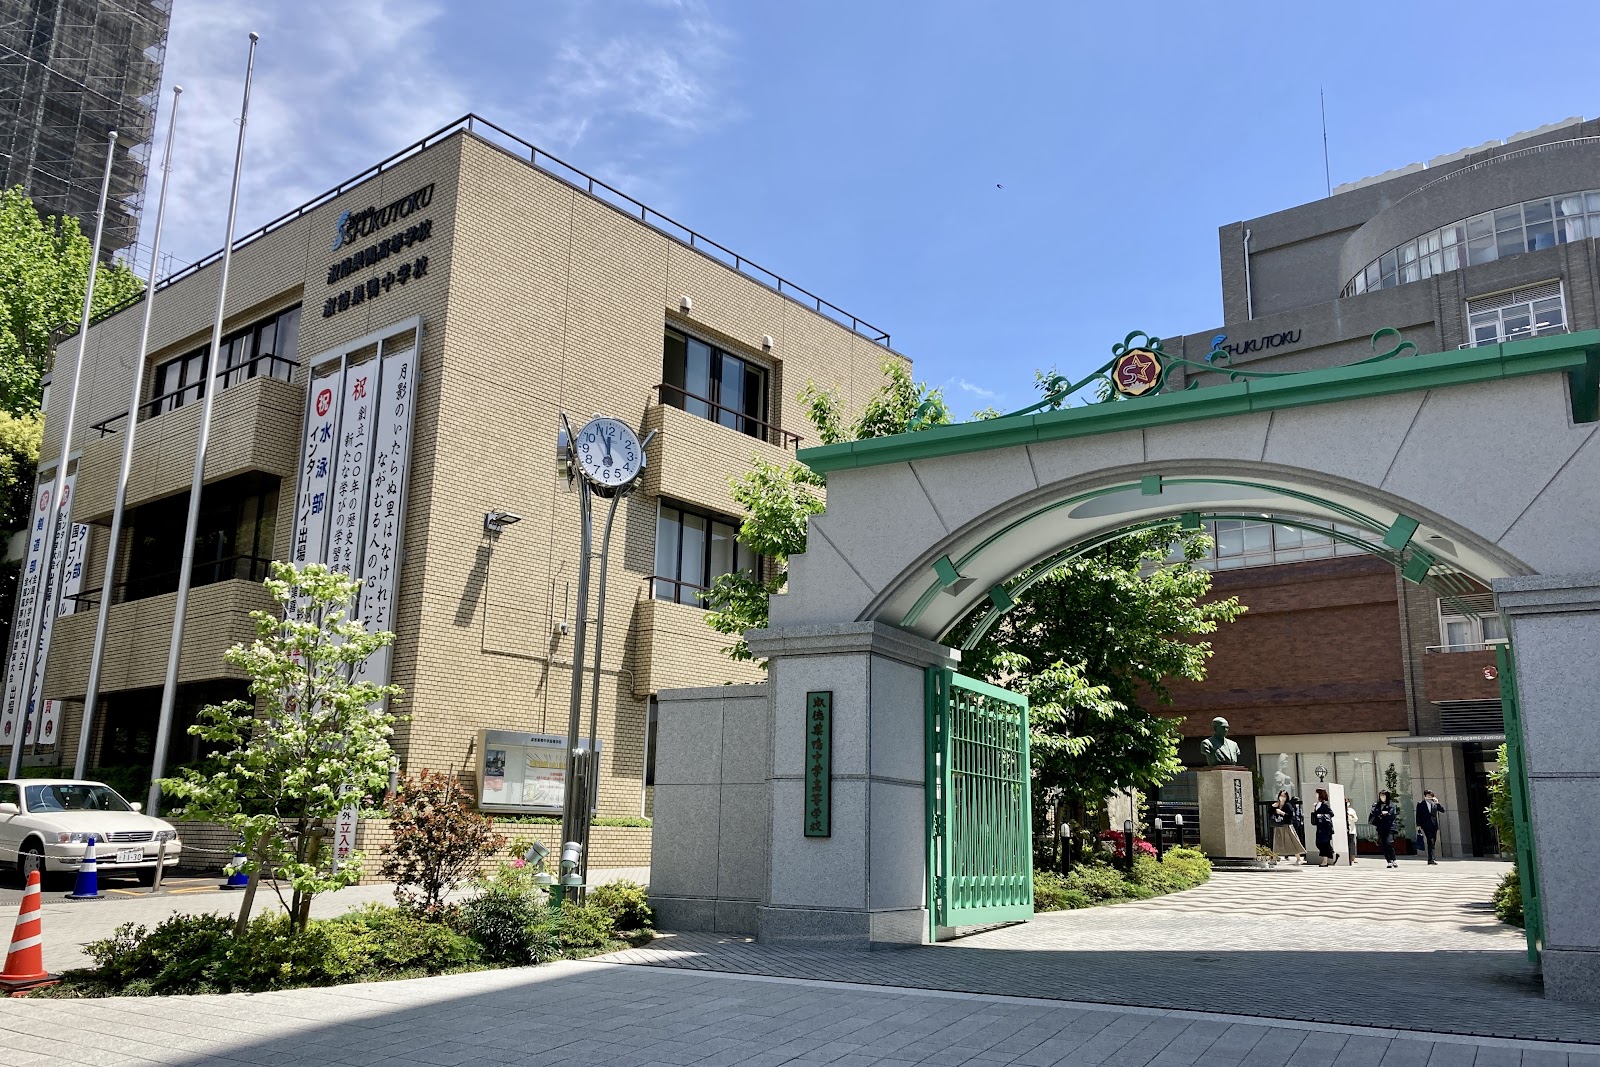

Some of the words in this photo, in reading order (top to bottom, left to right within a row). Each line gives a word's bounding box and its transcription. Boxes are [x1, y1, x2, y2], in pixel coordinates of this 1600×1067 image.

[343, 183, 435, 245] SHUKUTOKU
[1219, 329, 1302, 358] SHUKUTOKU
[352, 377, 368, 401] 祝
[317, 391, 331, 413] 祝
[605, 426, 616, 437] 12
[620, 430, 623, 440] 1
[586, 432, 596, 443] 10
[582, 443, 590, 453] 9
[625, 440, 632, 449] 2
[585, 454, 593, 464] 8
[627, 451, 634, 461] 3
[311, 421, 333, 516] 水泳部
[593, 464, 601, 474] 7
[623, 462, 630, 471] 4
[603, 469, 610, 479] 6
[614, 468, 622, 478] 5
[296, 426, 320, 561] インターハイ出場
[376, 363, 408, 632] 月影のいたらぬ里はなけれど
